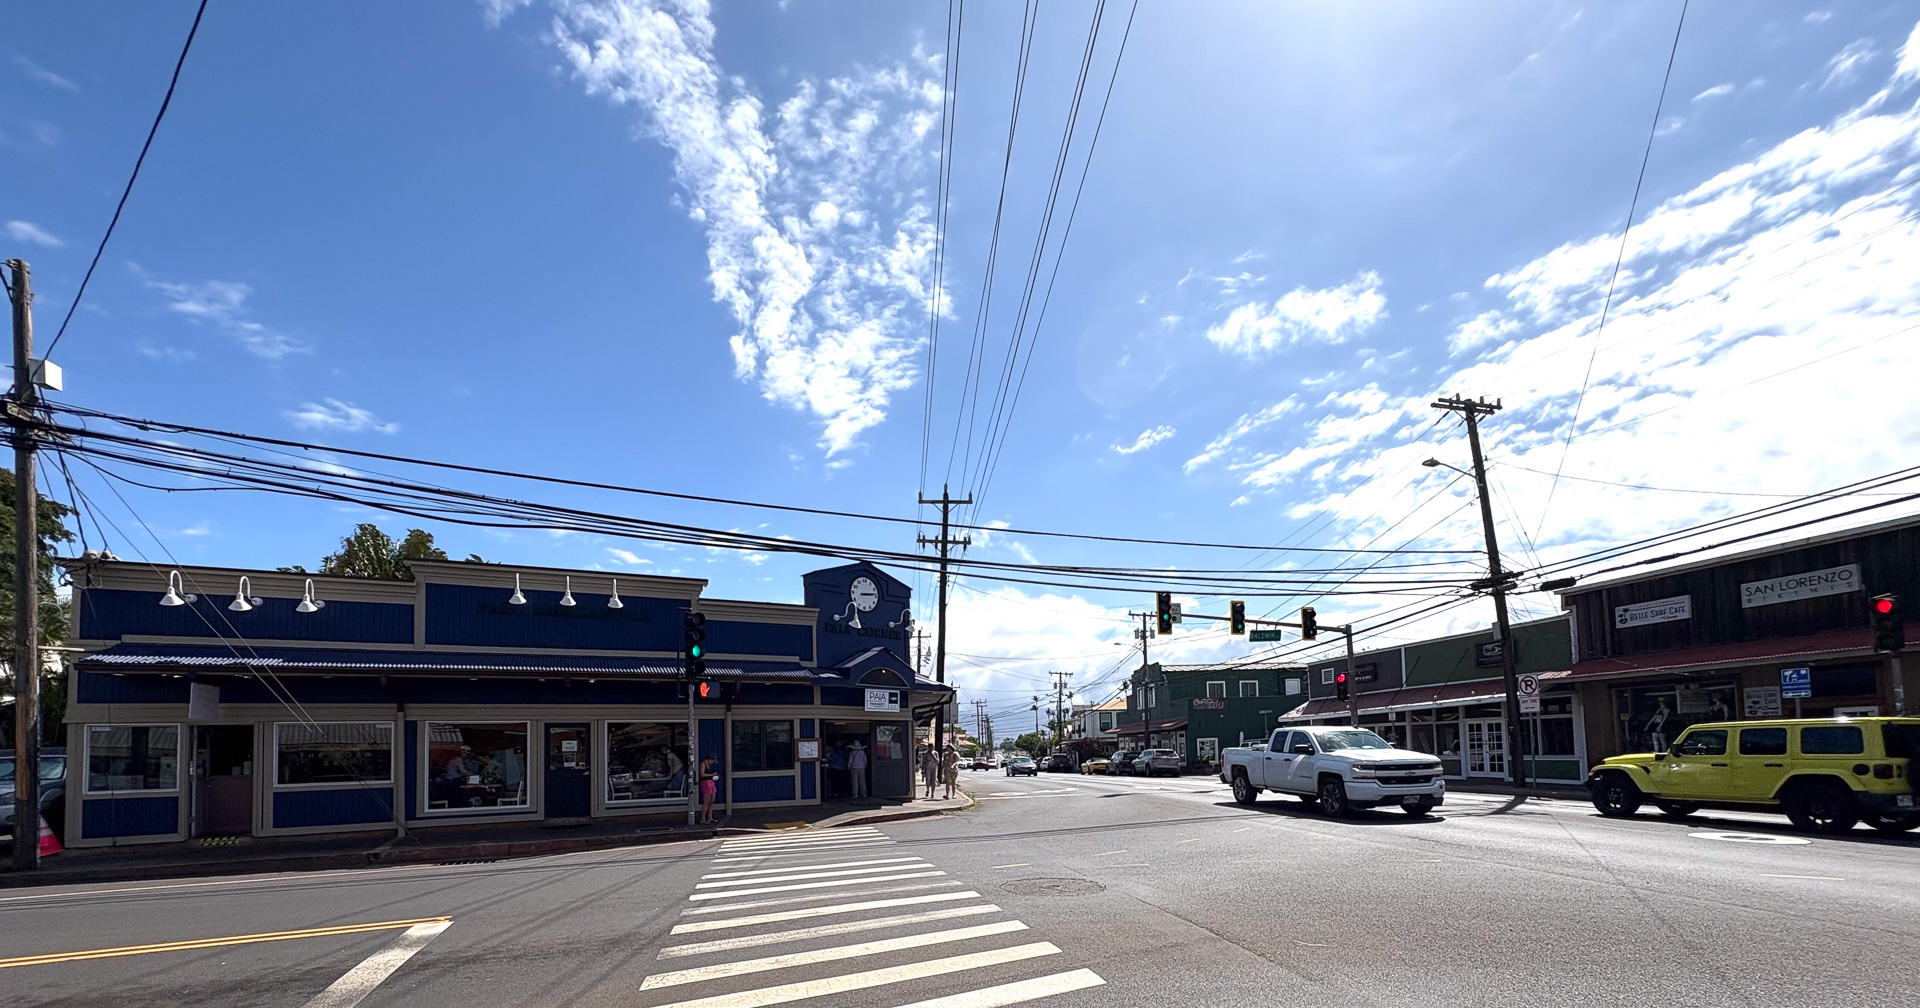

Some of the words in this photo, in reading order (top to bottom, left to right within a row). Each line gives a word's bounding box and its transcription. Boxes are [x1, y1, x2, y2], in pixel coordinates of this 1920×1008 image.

[1745, 583, 1774, 597] SAN
[1779, 569, 1852, 591] LORENZO
[1629, 612, 1648, 621] BELLE
[1650, 609, 1667, 618] SURF
[1669, 605, 1686, 615] CAFE
[857, 627, 902, 641] CORNER
[1250, 632, 1275, 640] BALDWIN
[870, 692, 886, 701] PAIA
